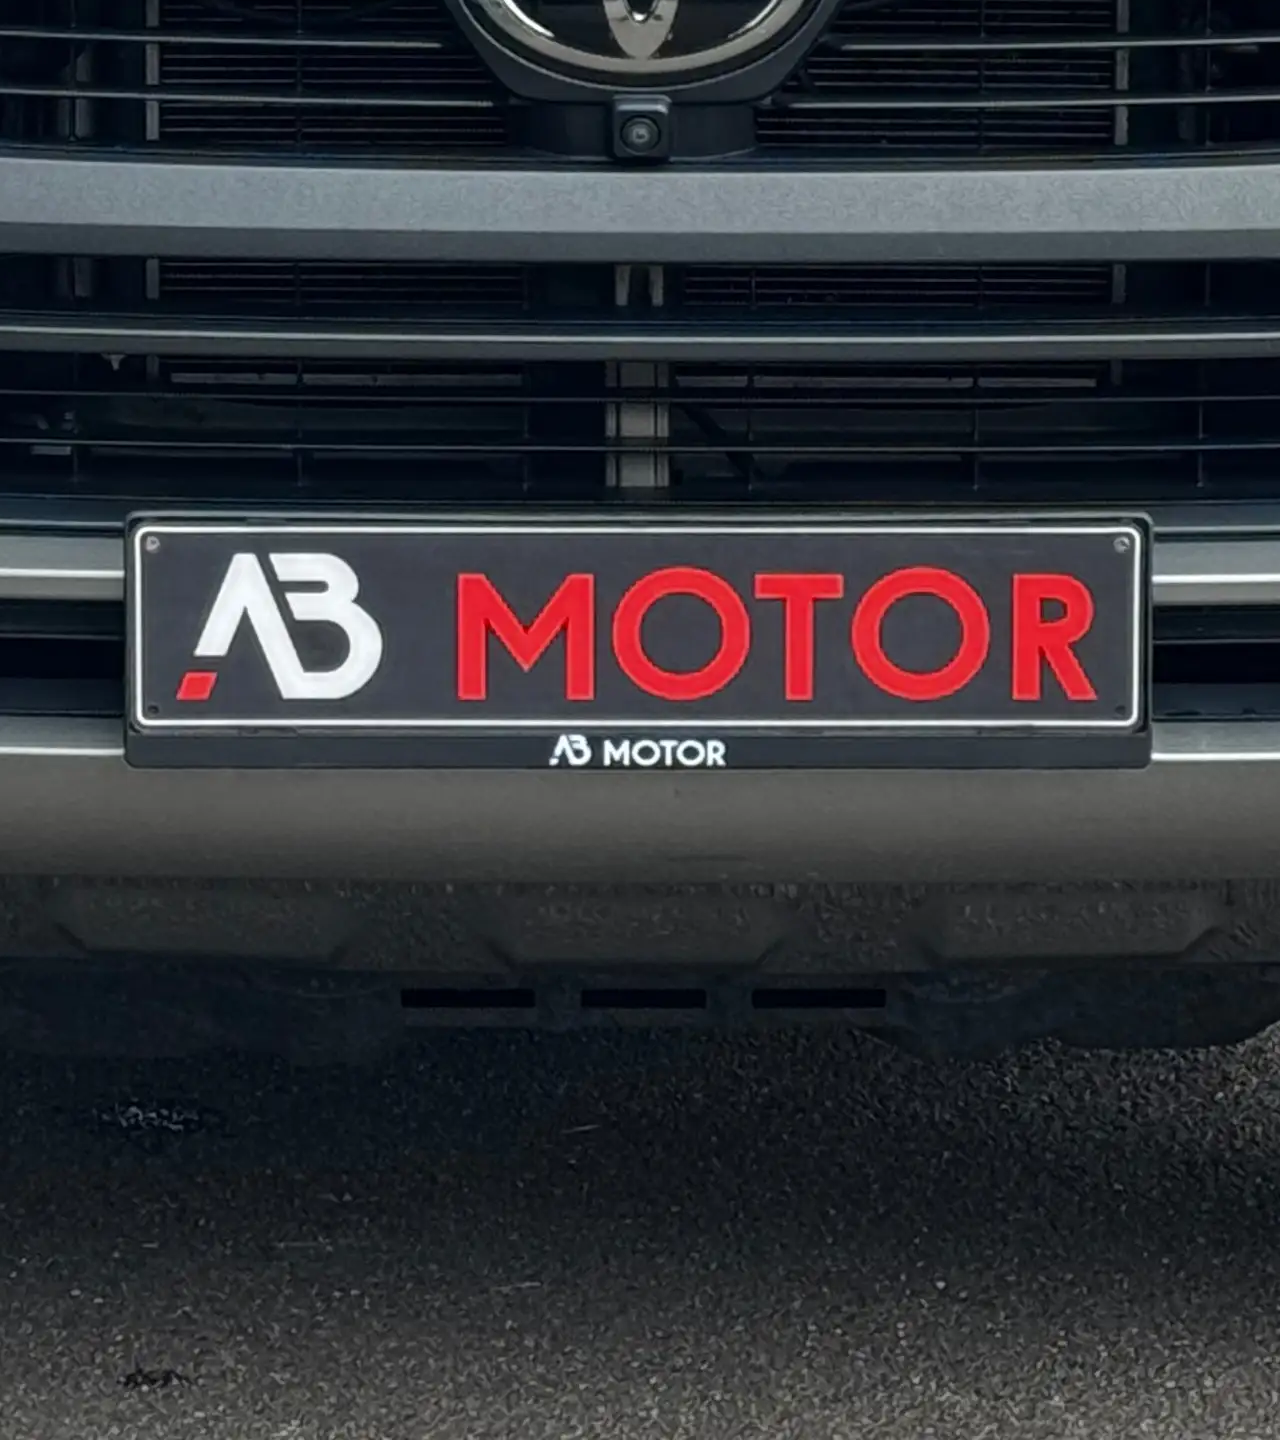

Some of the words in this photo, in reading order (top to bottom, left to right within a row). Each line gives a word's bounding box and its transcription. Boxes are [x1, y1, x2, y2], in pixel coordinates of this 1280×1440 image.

[176, 553, 382, 700] AB
[456, 567, 1099, 702] MOTOR
[549, 734, 592, 767] AB
[602, 739, 727, 767] MOTOR
